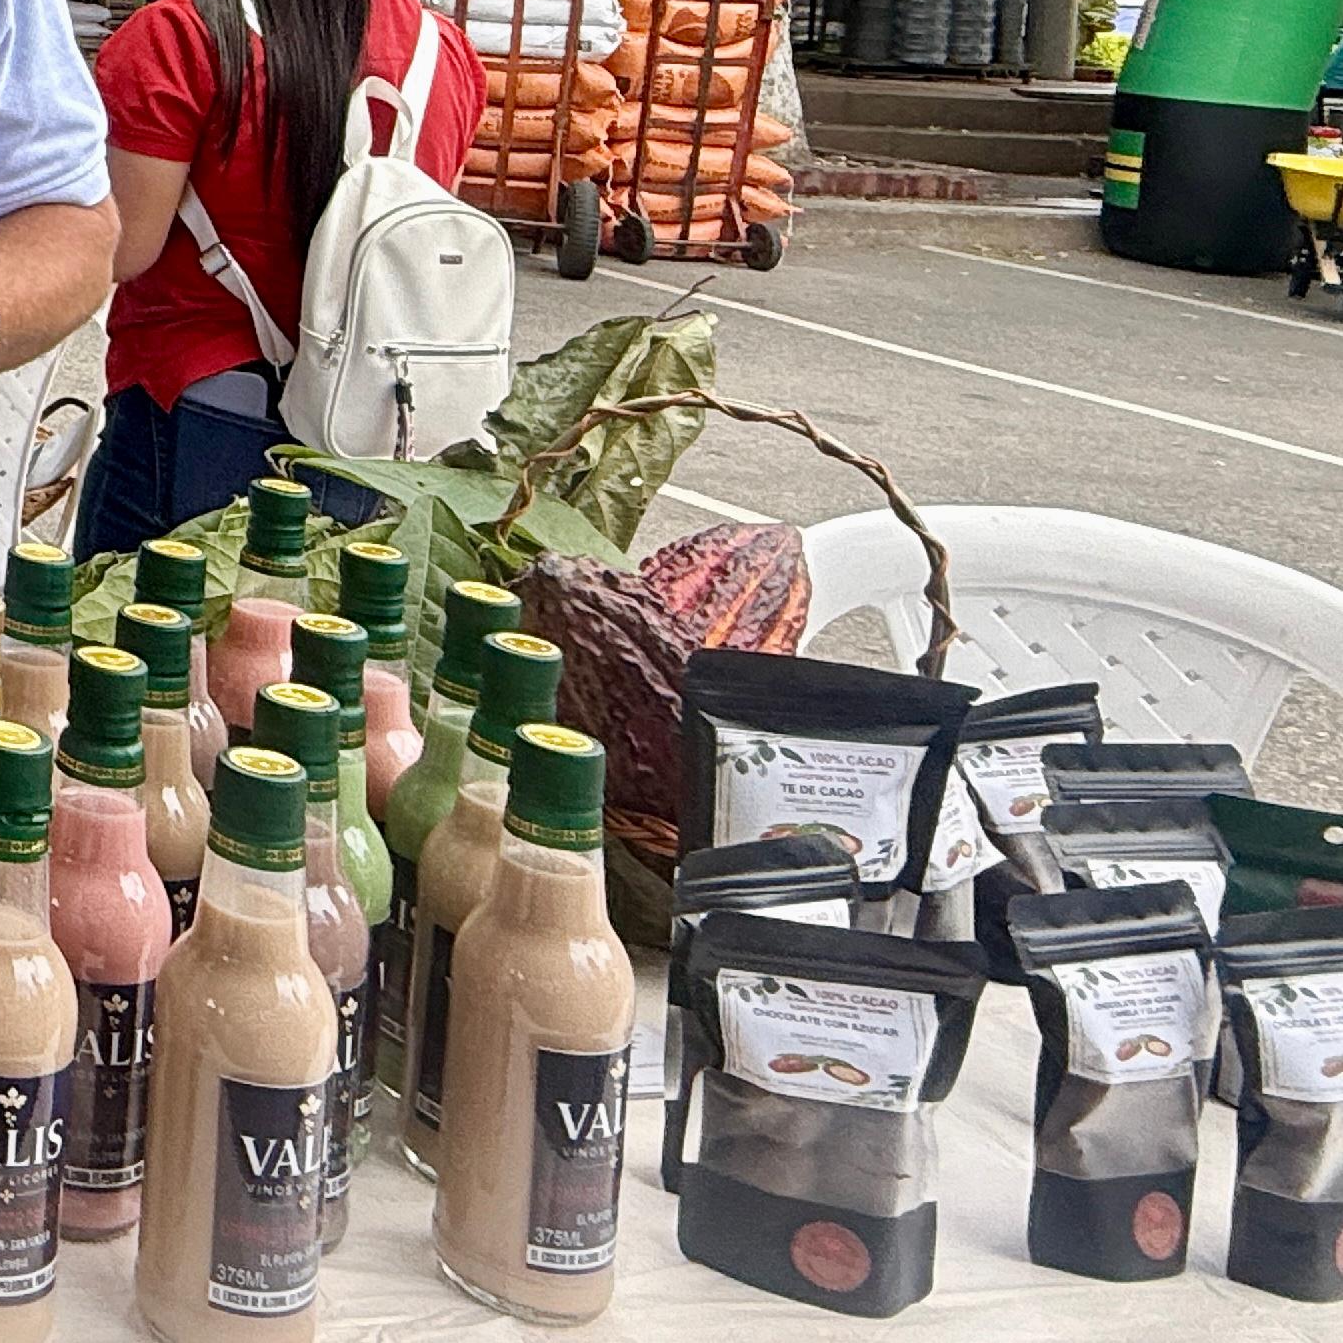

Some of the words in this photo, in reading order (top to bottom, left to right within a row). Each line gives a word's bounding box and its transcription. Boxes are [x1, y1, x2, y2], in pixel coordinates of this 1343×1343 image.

[846, 755, 897, 770] CACAO
[780, 782, 797, 795] TE
[799, 783, 816, 796] DE
[819, 787, 866, 800] CACAO
[850, 993, 900, 1011] CACAO
[753, 1007, 822, 1027] CHOCOLATE
[824, 1017, 849, 1031] CON
[851, 1022, 900, 1038] AZUCAR
[75, 1023, 155, 1067] ALI
[554, 1096, 623, 1141] VAL
[239, 1134, 322, 1178] VAL
[533, 1226, 585, 1248] 375ML
[216, 1262, 271, 1290] 375ML
